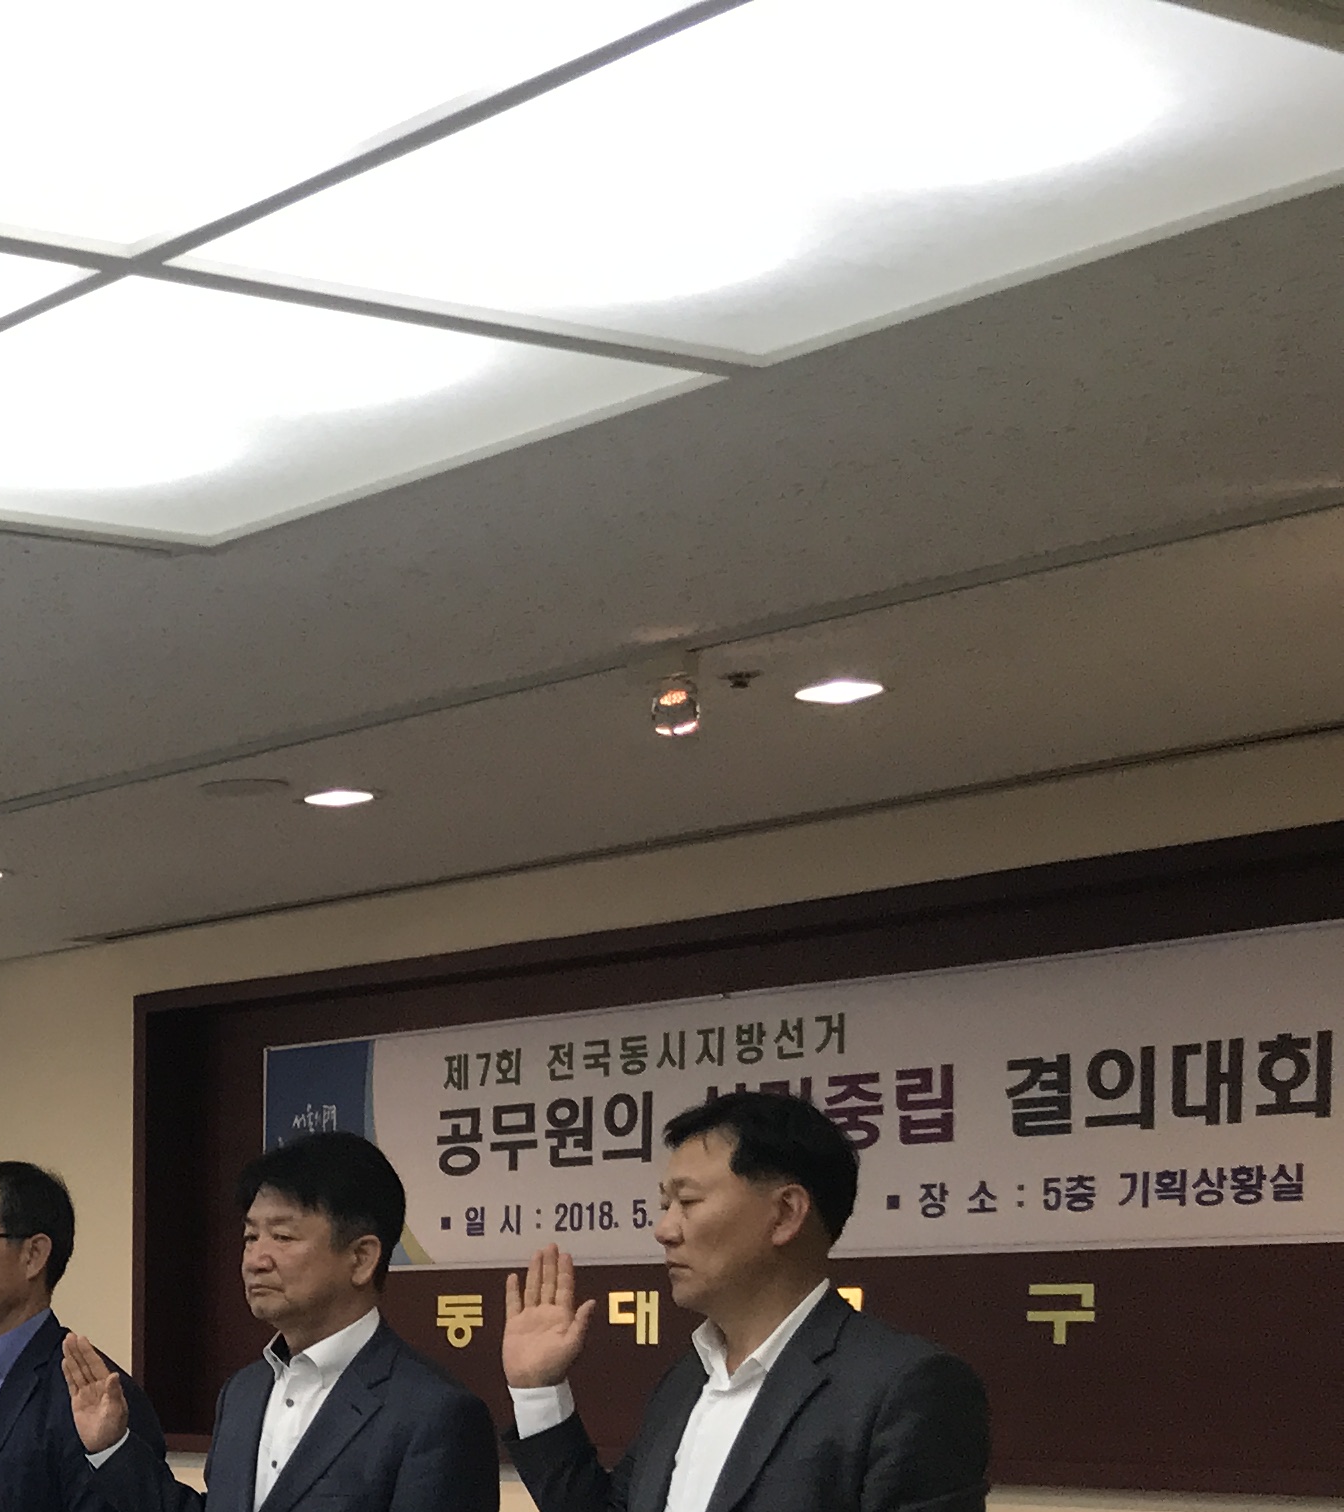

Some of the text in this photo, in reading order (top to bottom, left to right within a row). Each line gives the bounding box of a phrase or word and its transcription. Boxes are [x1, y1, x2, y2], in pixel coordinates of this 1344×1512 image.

[442, 1012, 847, 1092] 제7회 전국동시지방선거
[435, 1089, 653, 1177] 공무원의
[1004, 1029, 1334, 1138] 결의대회
[464, 1206, 487, 1238] 일
[499, 1203, 522, 1235] 시
[554, 1199, 619, 1233] 2018.
[918, 1181, 949, 1219] 장
[967, 1180, 998, 1215] 소
[1042, 1174, 1098, 1212] 5층
[1117, 1162, 1305, 1208] 기획상황실
[435, 1283, 1096, 1349] 동 대 구
